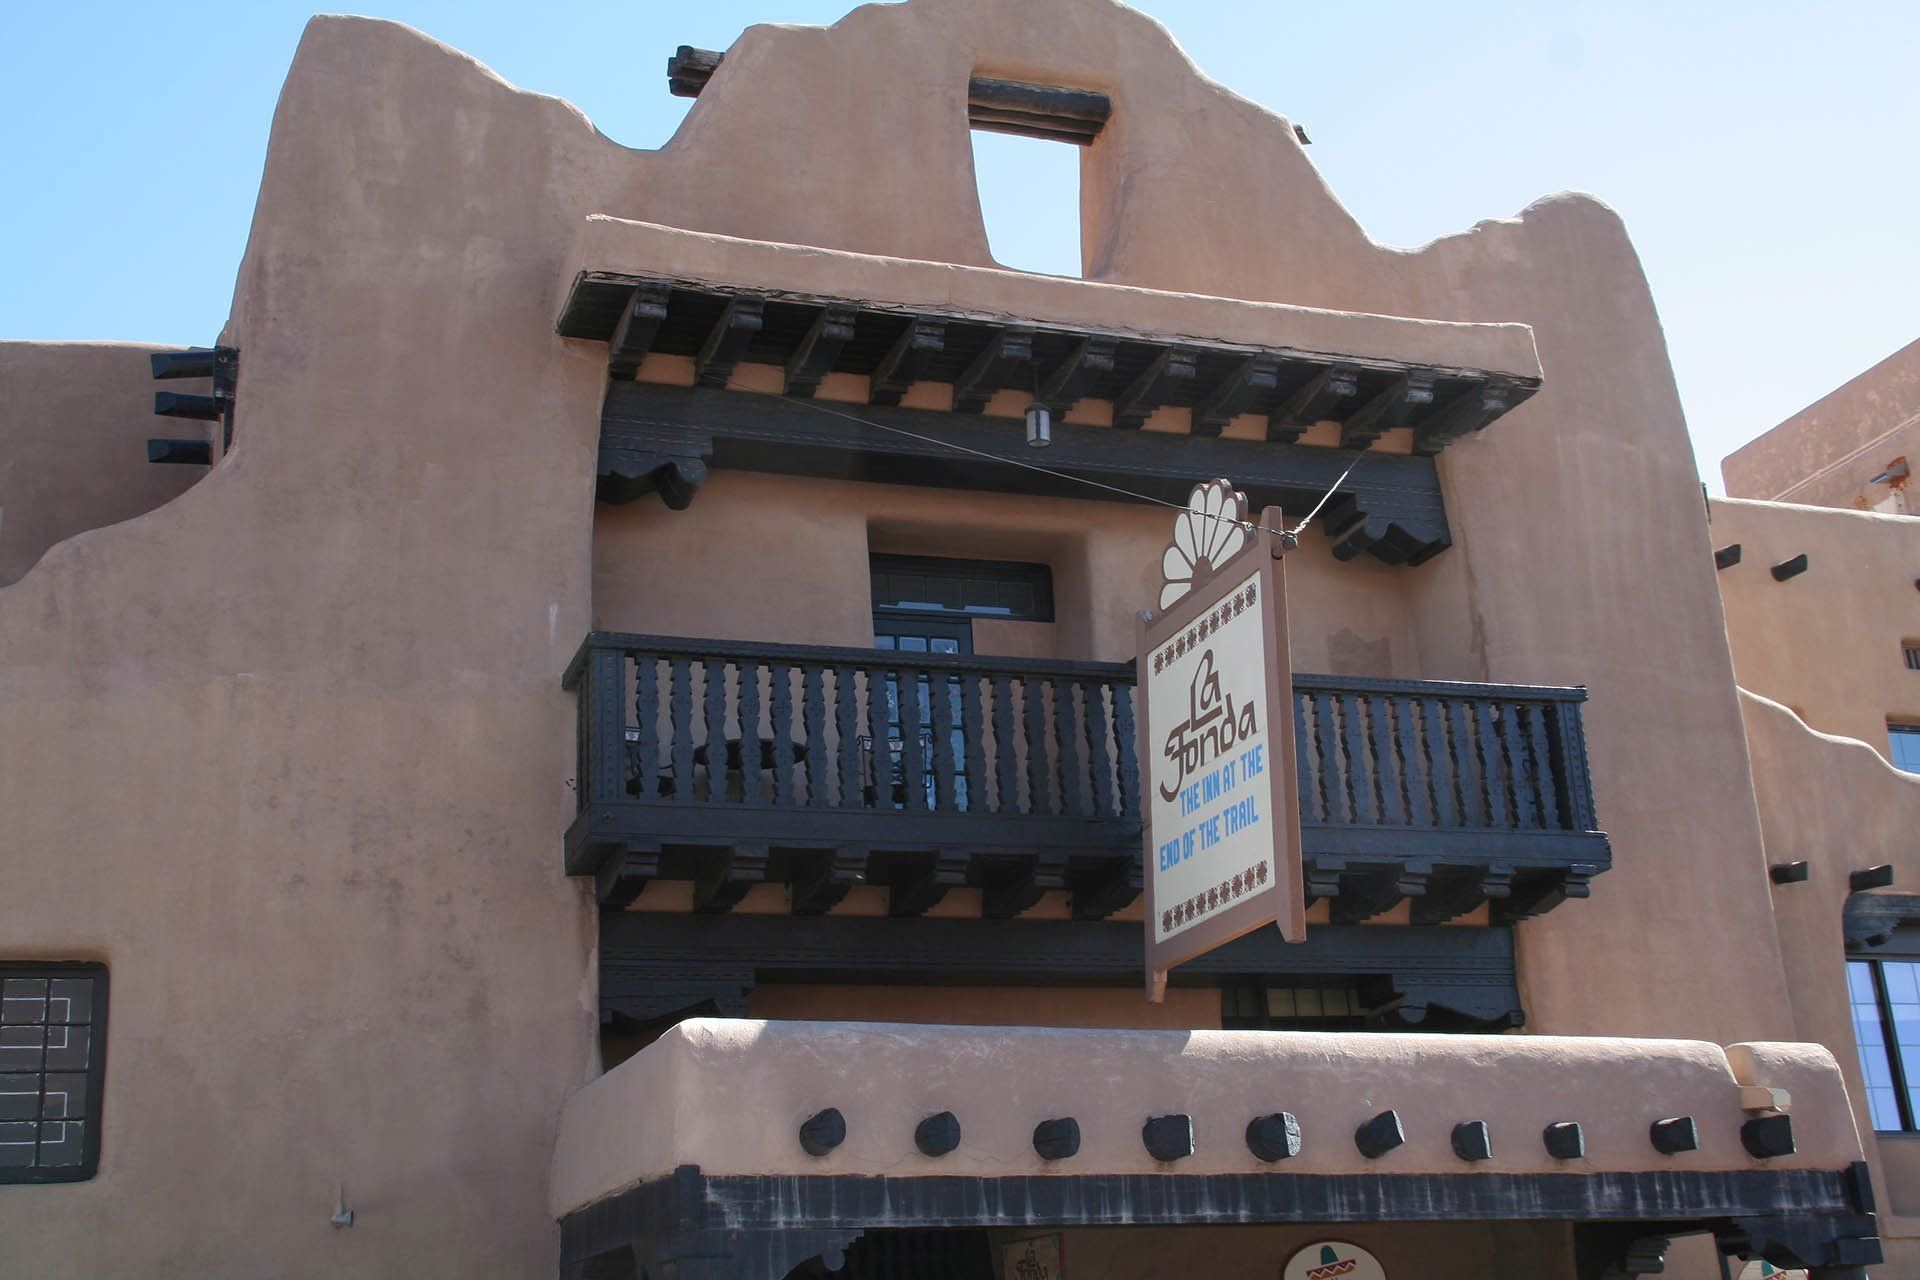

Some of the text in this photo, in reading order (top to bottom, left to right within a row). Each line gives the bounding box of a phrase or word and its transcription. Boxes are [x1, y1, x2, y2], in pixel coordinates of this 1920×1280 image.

[1190, 649, 1223, 733] La
[1180, 744, 1263, 817] THE INN AT THE
[1160, 795, 1259, 872] END OF THE TRAIL
